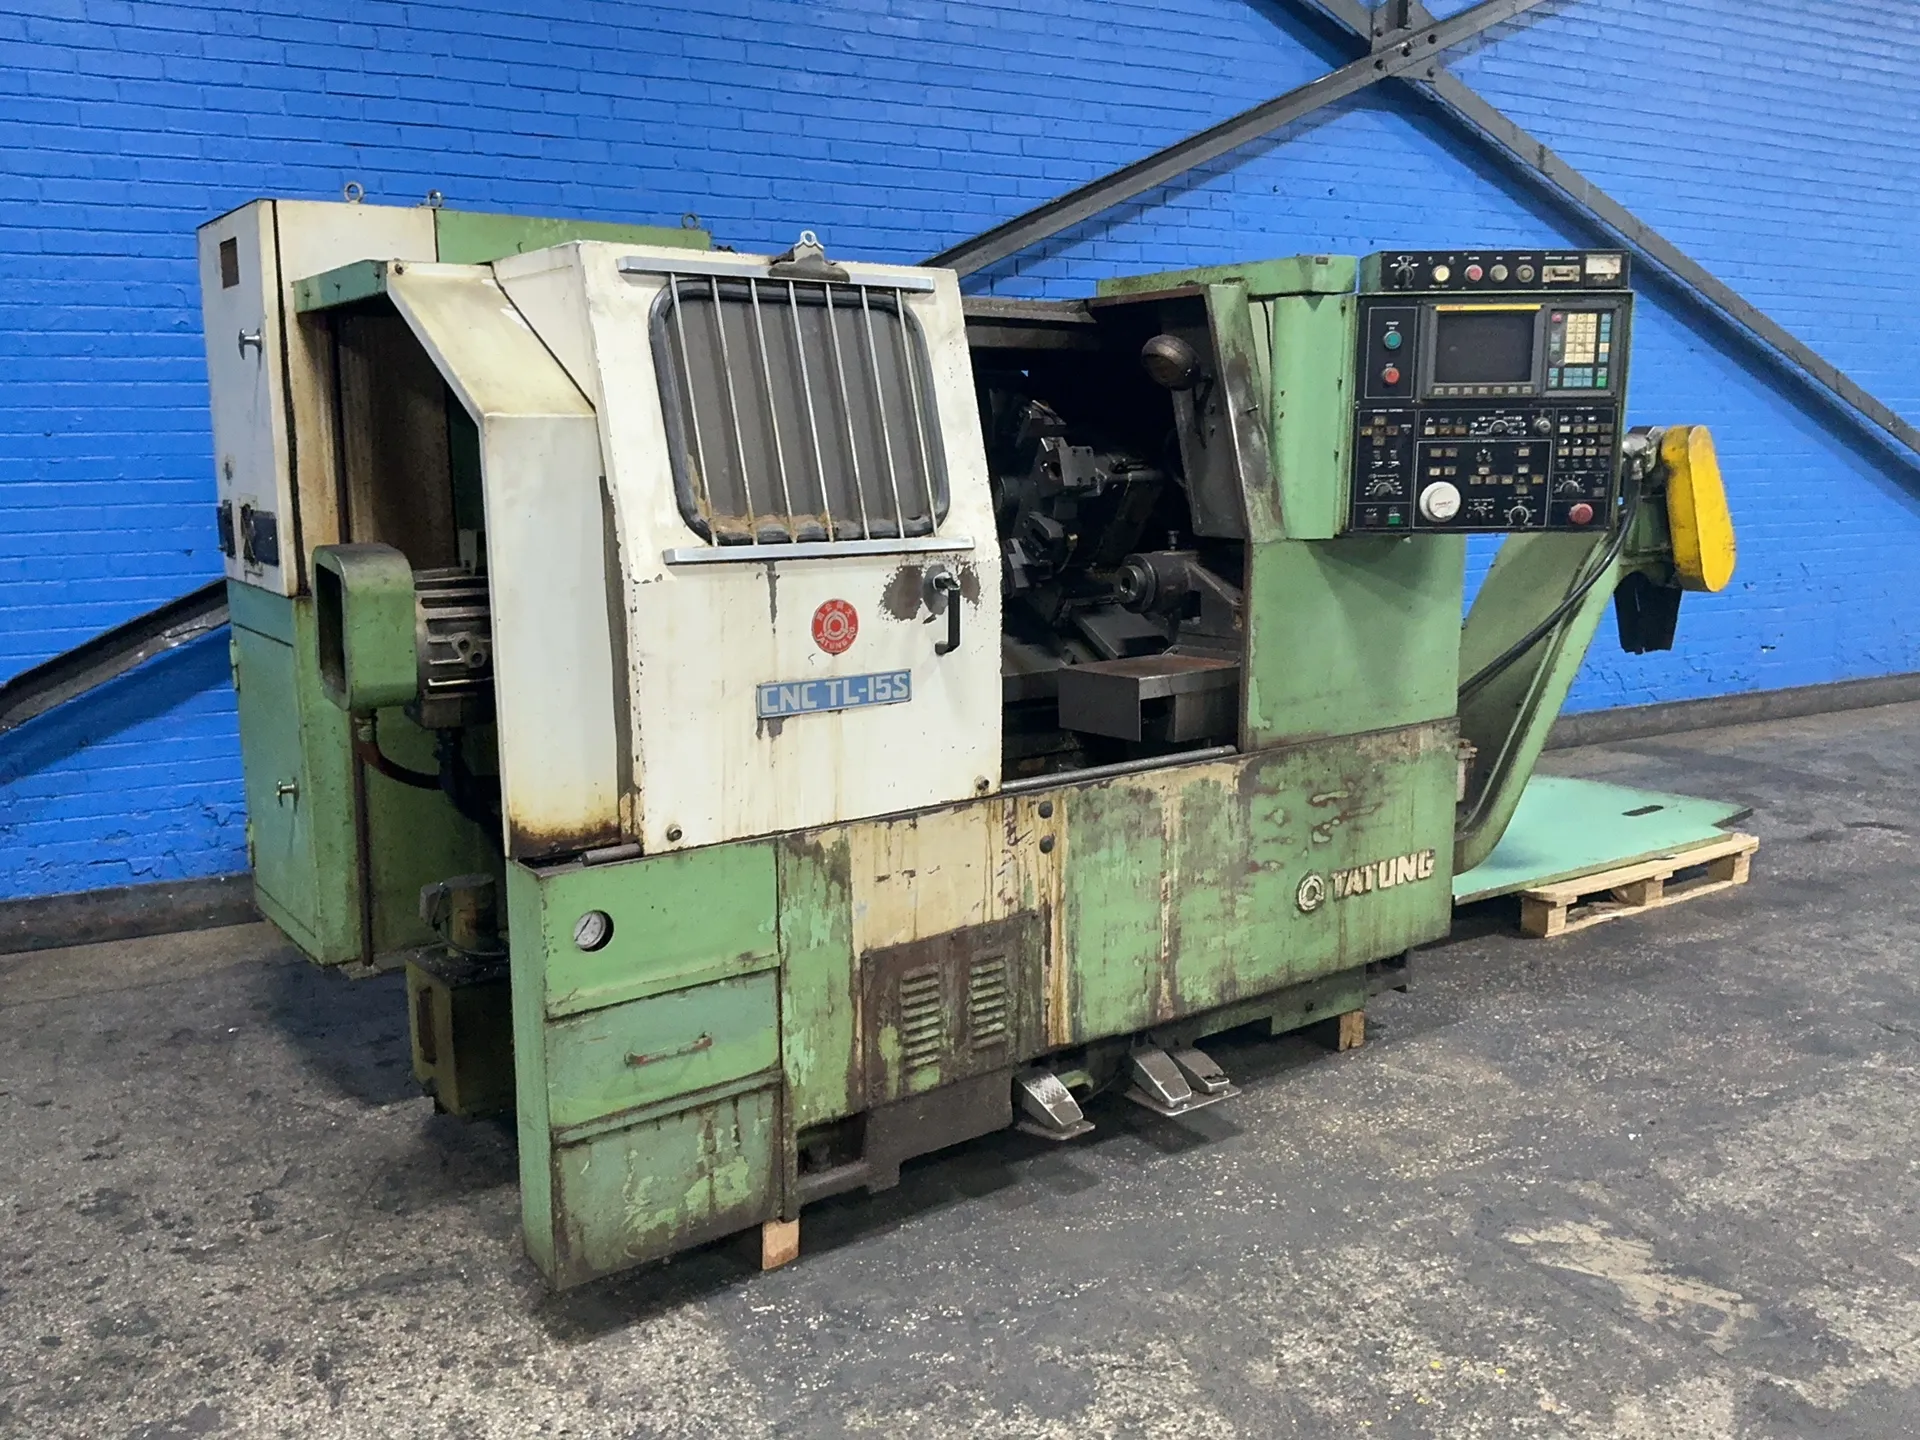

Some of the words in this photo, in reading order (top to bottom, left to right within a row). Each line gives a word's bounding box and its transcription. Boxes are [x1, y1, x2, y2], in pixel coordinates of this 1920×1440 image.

[817, 631, 848, 650] TATUNG
[761, 682, 818, 714] CNC
[825, 673, 909, 706] TL-15S
[1330, 848, 1435, 900] TATUNG
